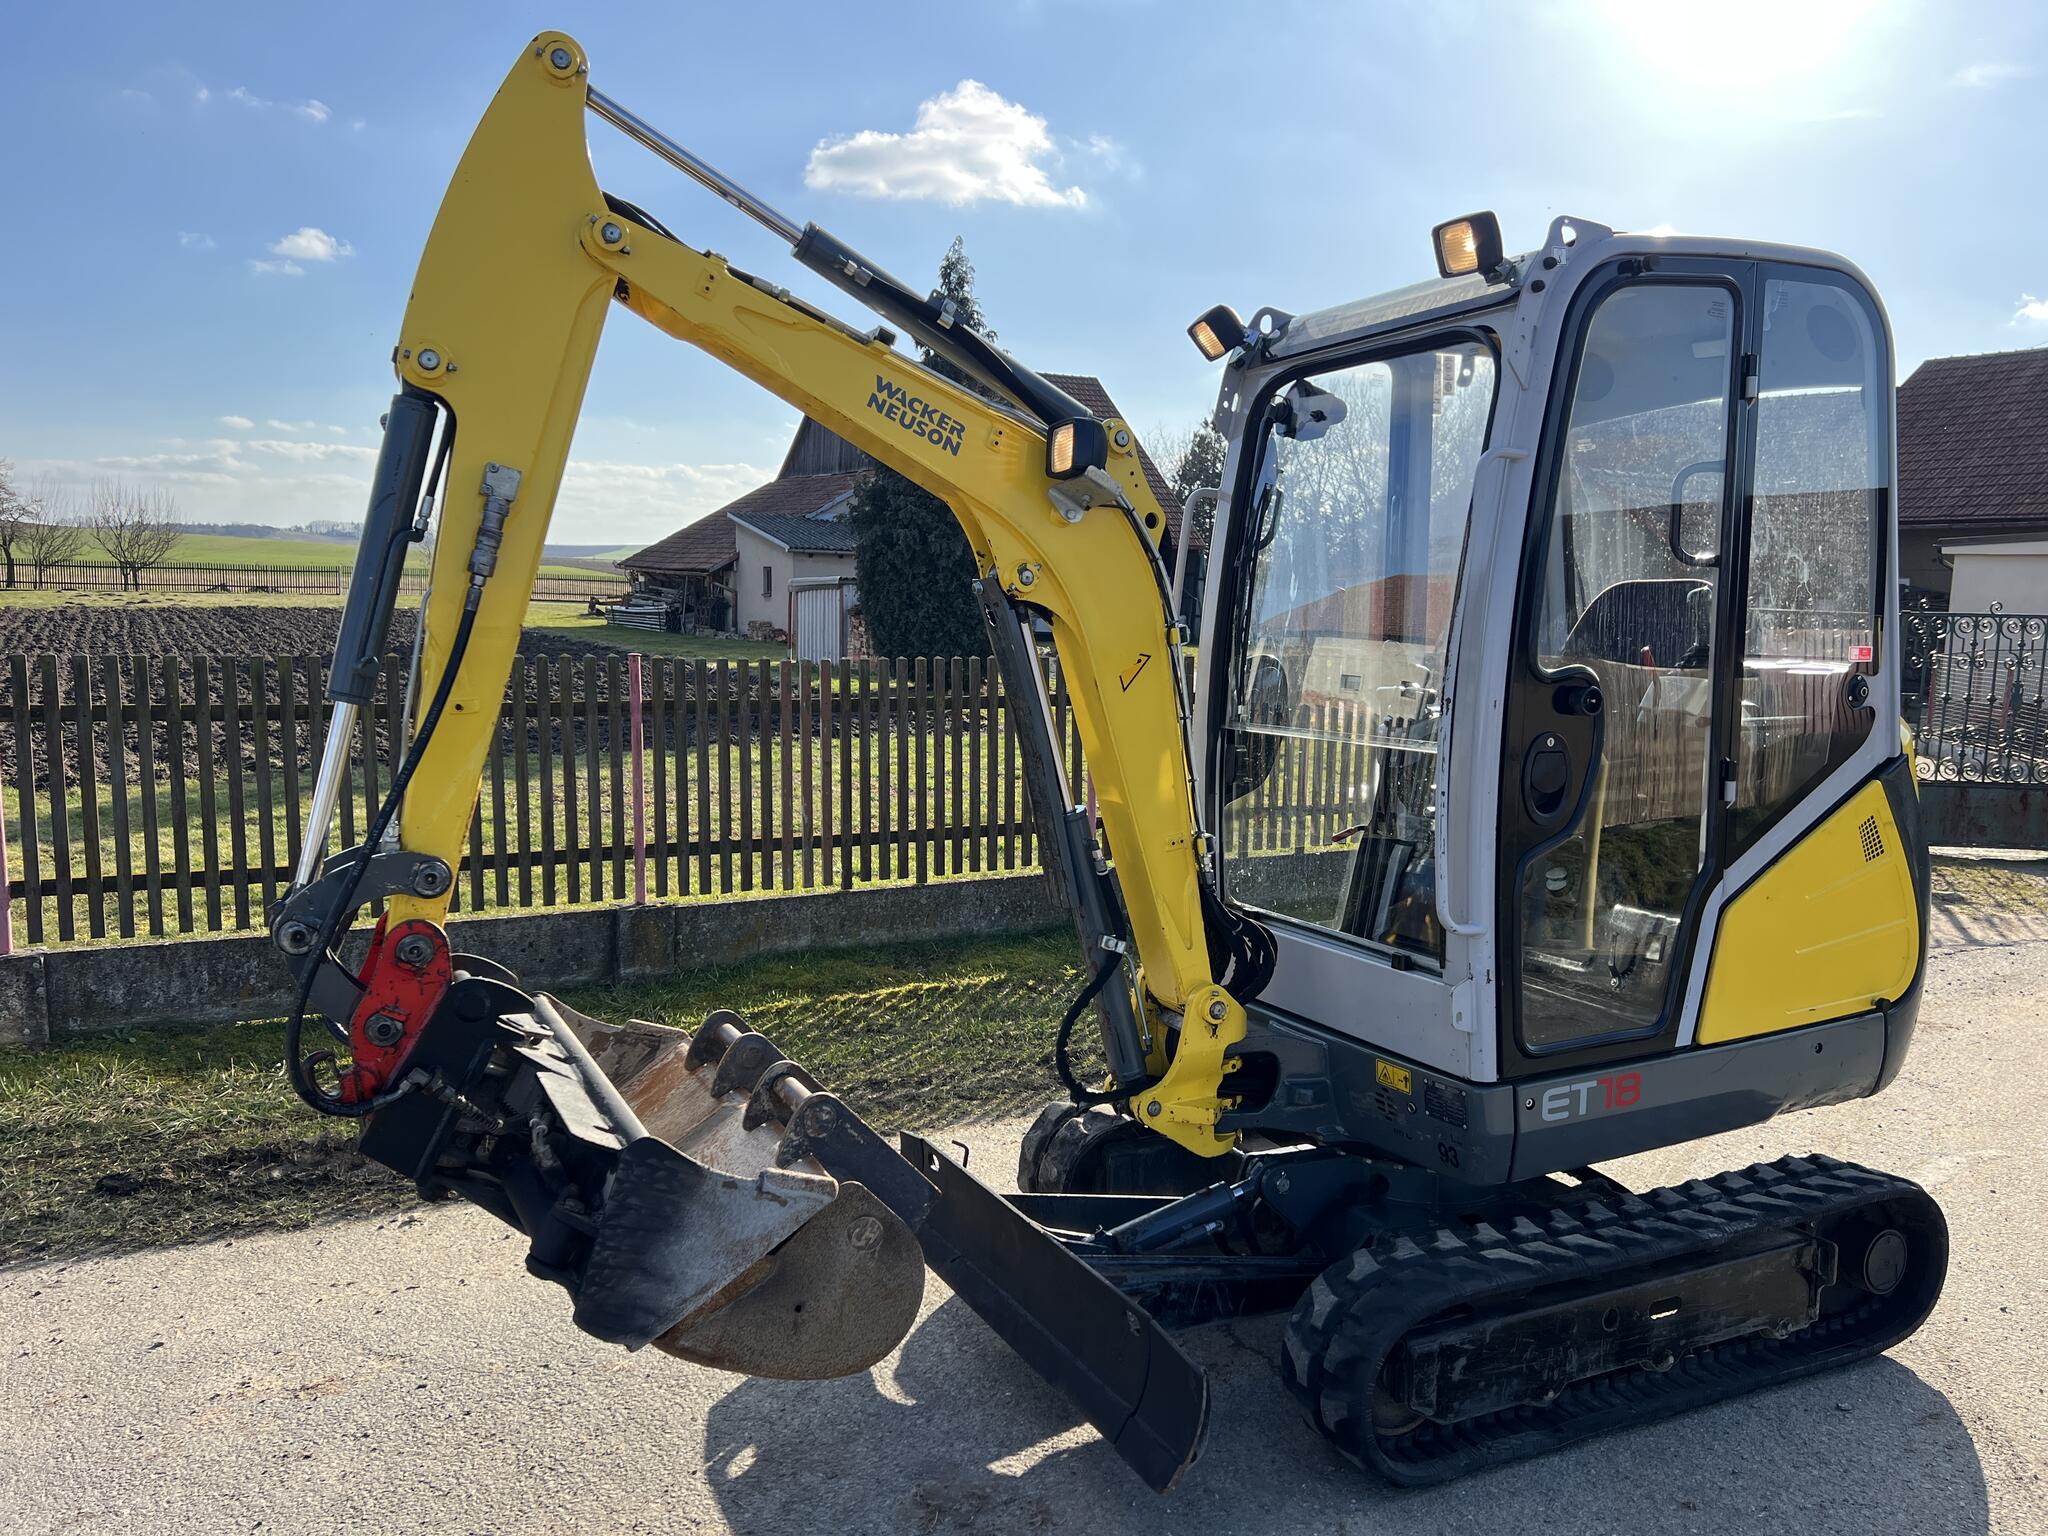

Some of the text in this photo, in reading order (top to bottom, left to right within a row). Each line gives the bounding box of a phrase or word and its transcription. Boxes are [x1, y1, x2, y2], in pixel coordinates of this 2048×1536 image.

[866, 392, 962, 457] NEUSON
[876, 374, 965, 441] WACKER
[1542, 1071, 1642, 1122] ET18
[1437, 1141, 1460, 1169] 93
